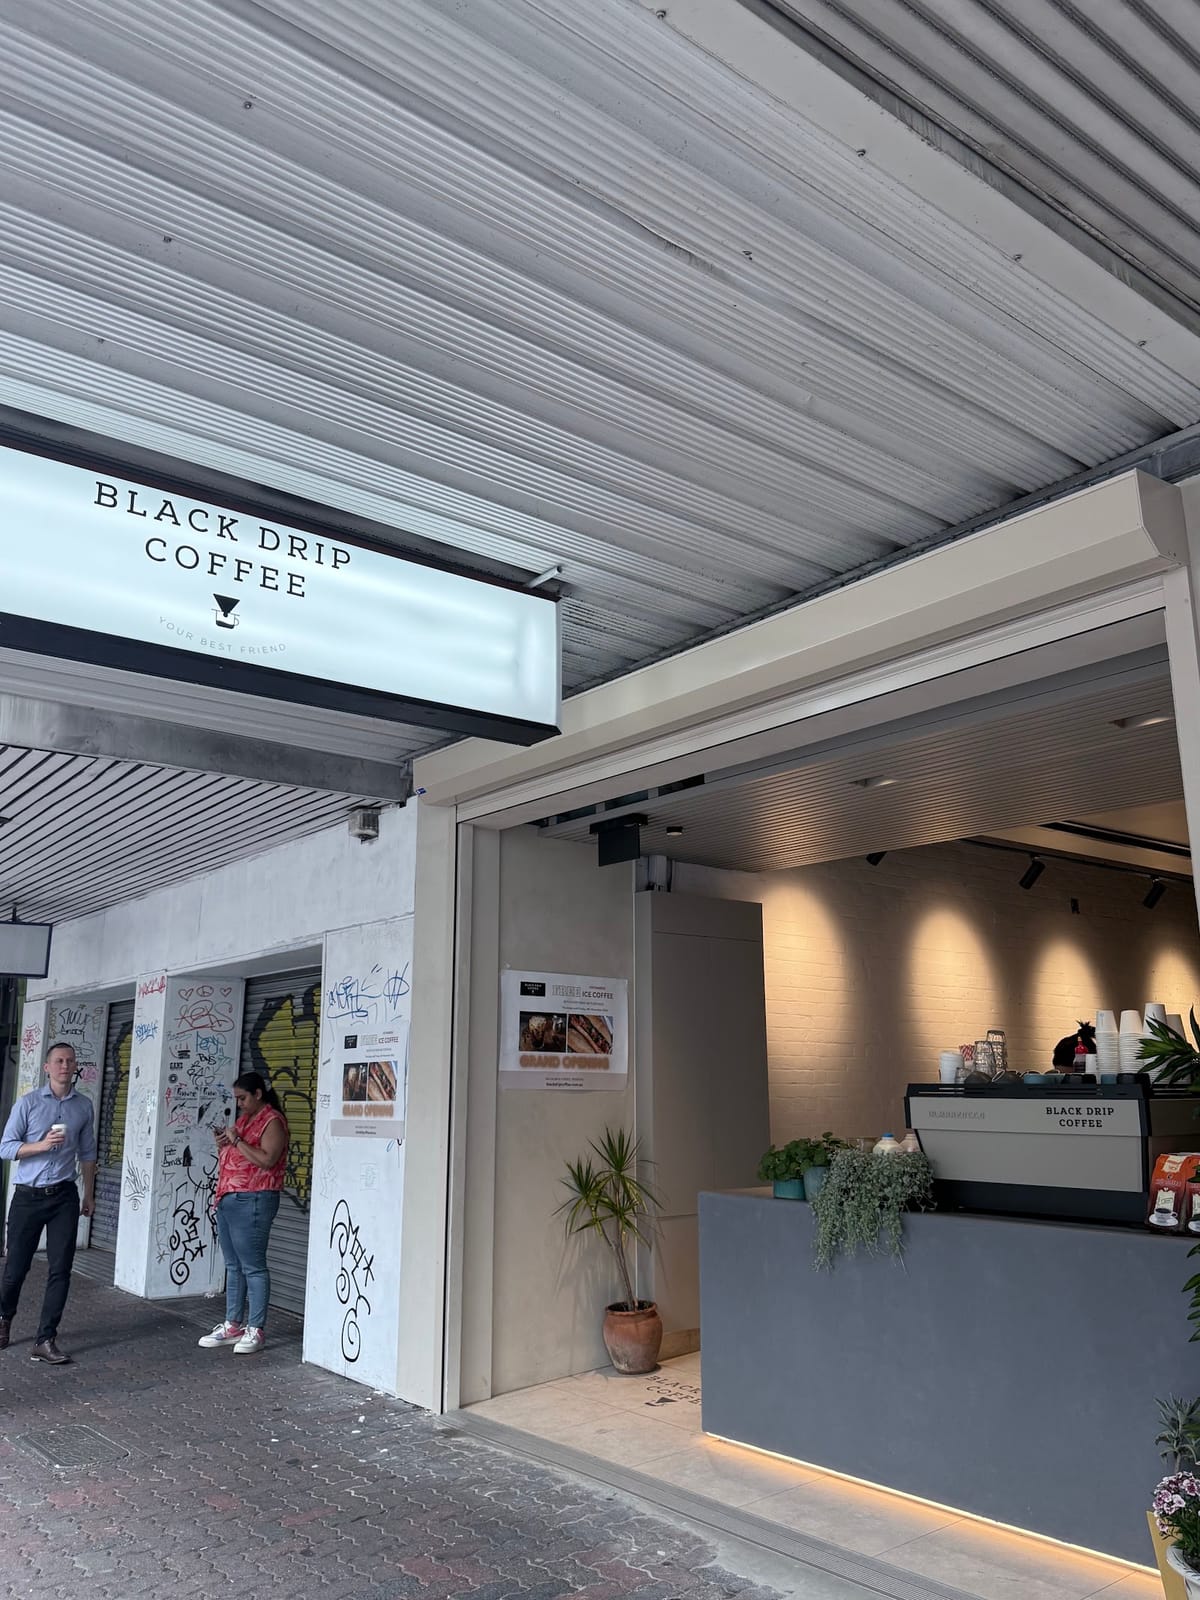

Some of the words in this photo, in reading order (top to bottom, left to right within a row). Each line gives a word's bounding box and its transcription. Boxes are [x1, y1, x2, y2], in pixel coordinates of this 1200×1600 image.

[94, 481, 239, 541] BLACK
[258, 526, 351, 570] DRIP
[145, 537, 306, 598] COFFEE
[159, 615, 194, 641] YOUR
[200, 637, 233, 652] BEST
[240, 642, 286, 655] FRIEND
[592, 991, 614, 1000] COFFEE
[1046, 1107, 1082, 1116] BLACK
[1086, 1107, 1115, 1116] DRIP
[1059, 1118, 1103, 1128] COFFEE
